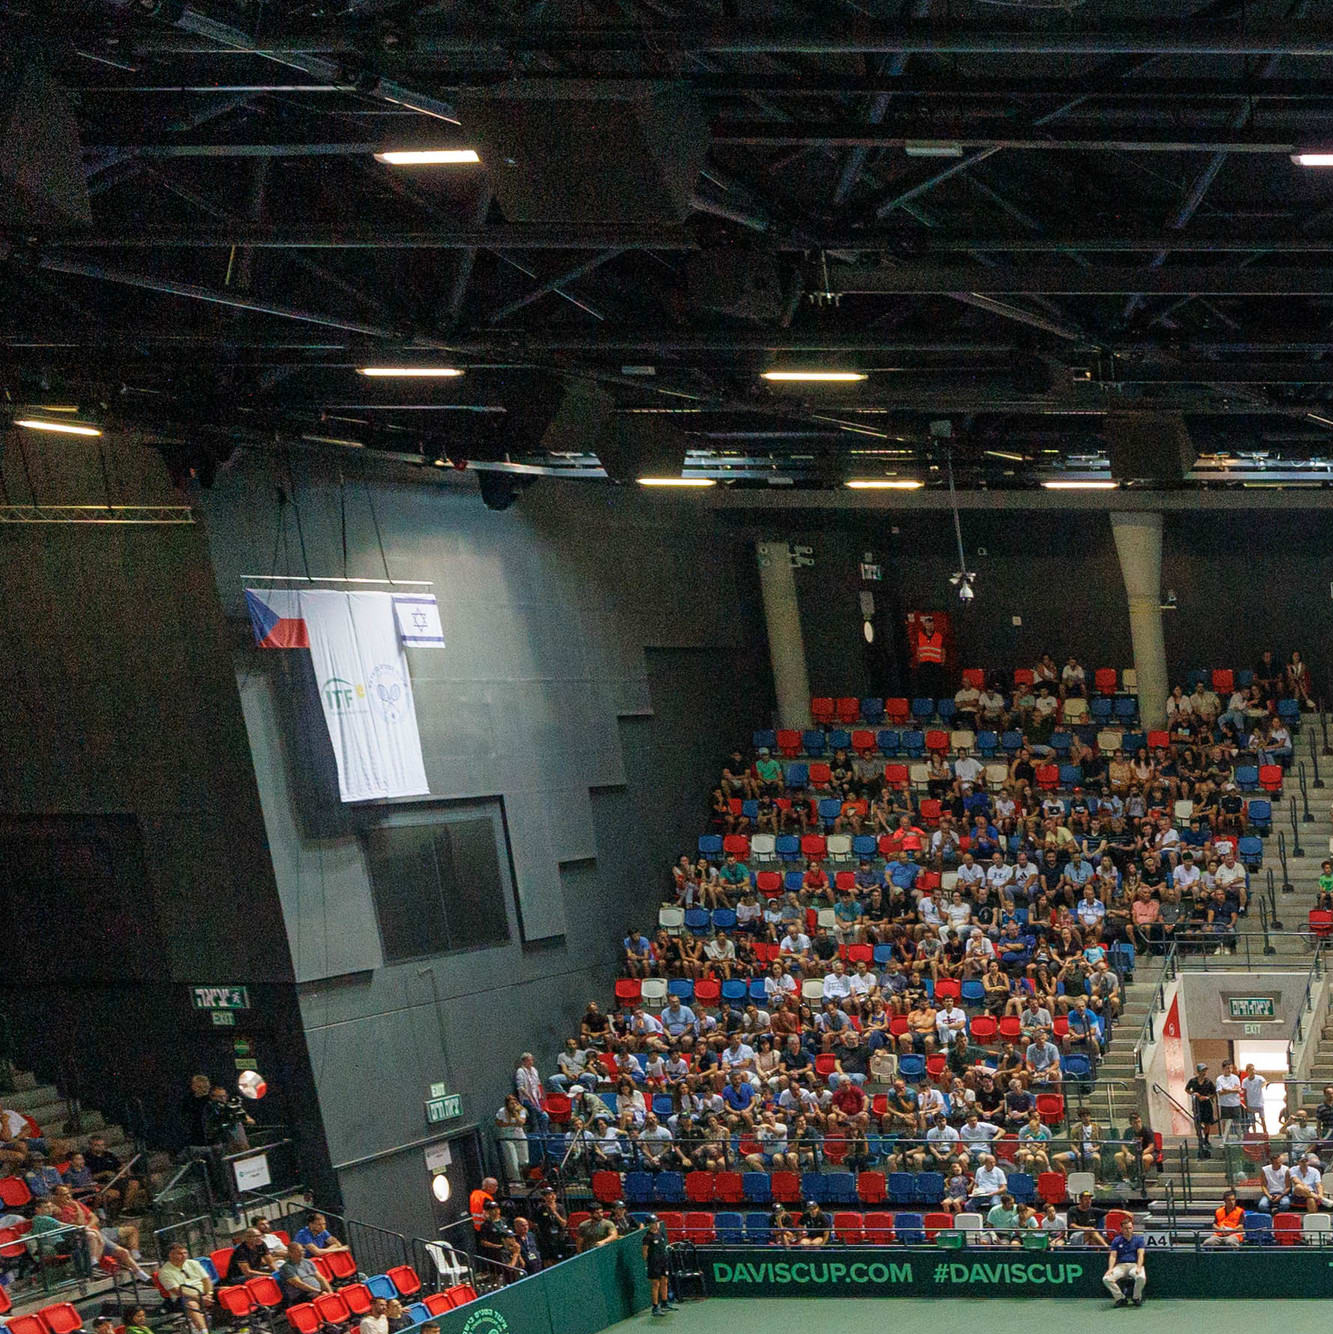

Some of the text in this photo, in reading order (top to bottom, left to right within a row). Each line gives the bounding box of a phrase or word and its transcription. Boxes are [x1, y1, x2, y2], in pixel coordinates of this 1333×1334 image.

[1147, 1235, 1168, 1246] A4
[713, 1262, 1083, 1284] DAVISCUP.COM #DAVISCUP
